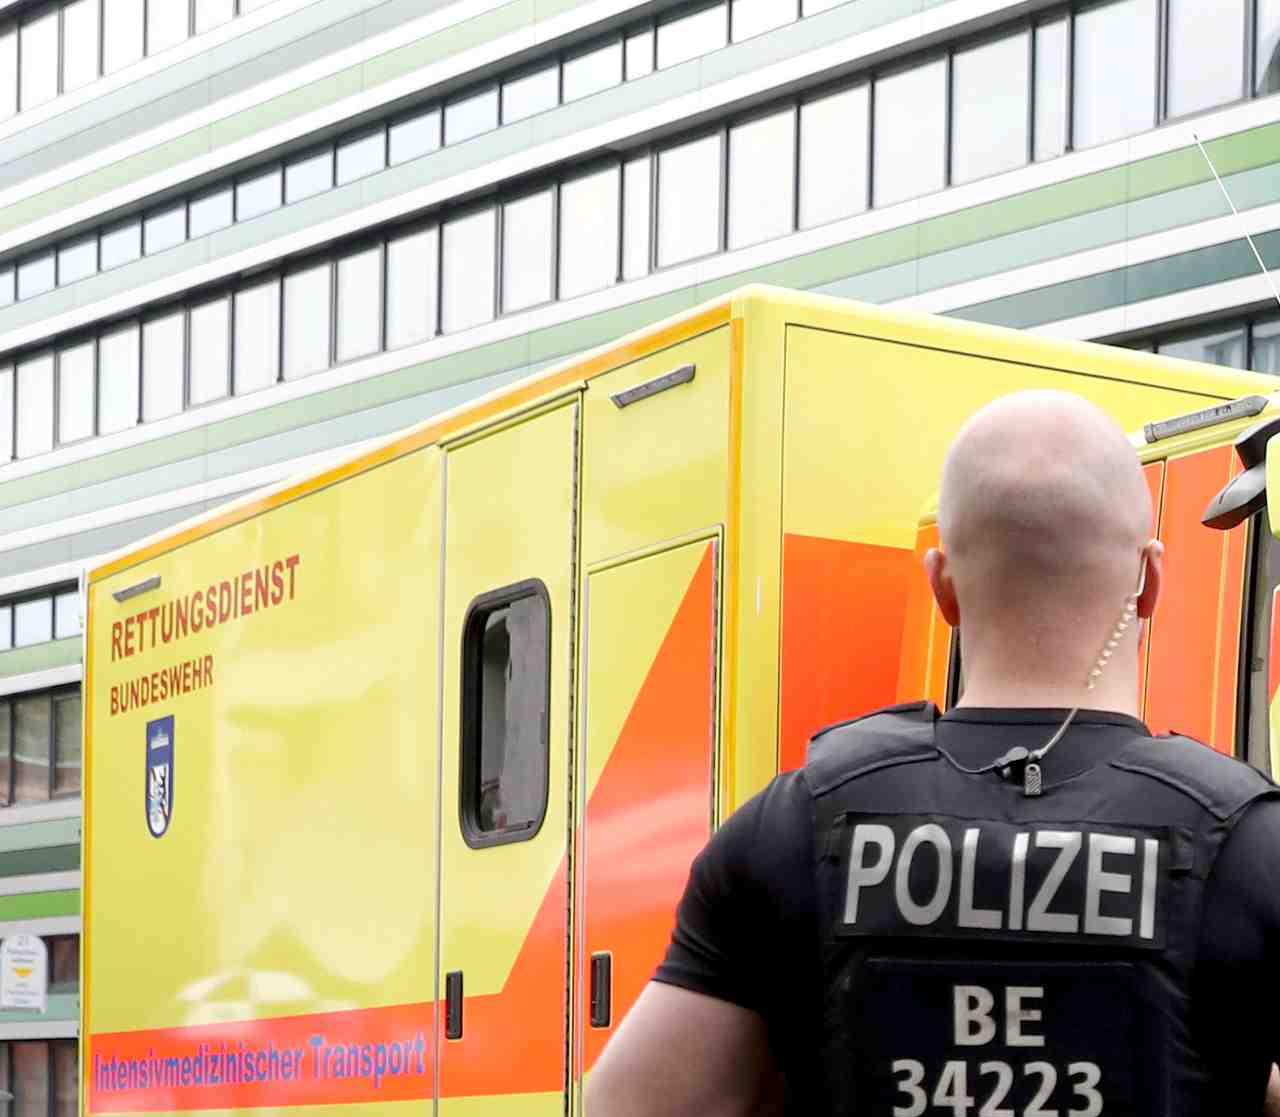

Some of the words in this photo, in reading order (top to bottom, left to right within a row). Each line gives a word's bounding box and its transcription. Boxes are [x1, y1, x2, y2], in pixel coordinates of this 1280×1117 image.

[111, 554, 300, 662] RETTUNGSDIENST
[110, 654, 214, 716] BUNDESWEHR
[842, 823, 1159, 939] POLIZEI
[953, 985, 1045, 1047] BE
[95, 1041, 305, 1091] Intensivmedizinischer
[308, 1032, 426, 1088] Transport
